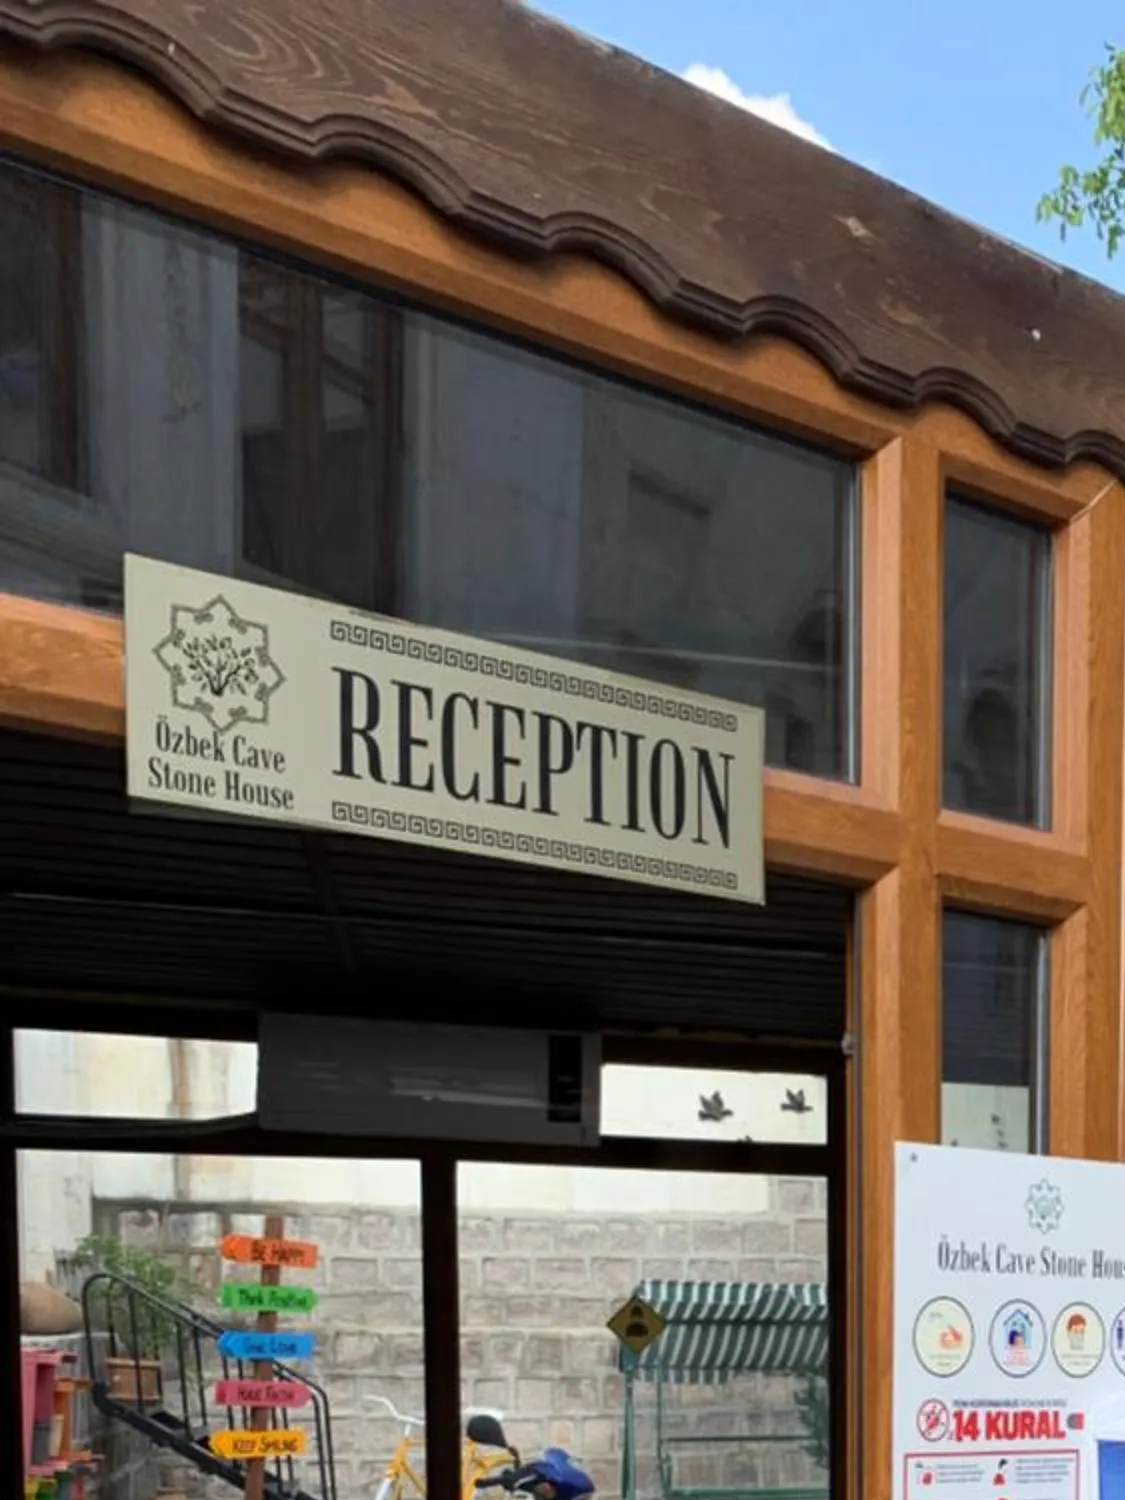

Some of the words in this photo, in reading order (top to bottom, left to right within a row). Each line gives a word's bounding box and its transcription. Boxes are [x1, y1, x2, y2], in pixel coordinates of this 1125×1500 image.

[155, 714, 226, 763] Özbek
[232, 733, 286, 774] Cave
[332, 666, 735, 849] RECEPTION
[148, 758, 217, 798] Stone
[224, 770, 295, 811] House
[937, 1234, 991, 1274] Özbek
[996, 1243, 1036, 1277] Cave
[1040, 1246, 1088, 1279] Stone
[953, 1409, 980, 1441] 14
[985, 1409, 1066, 1441] KURAL
